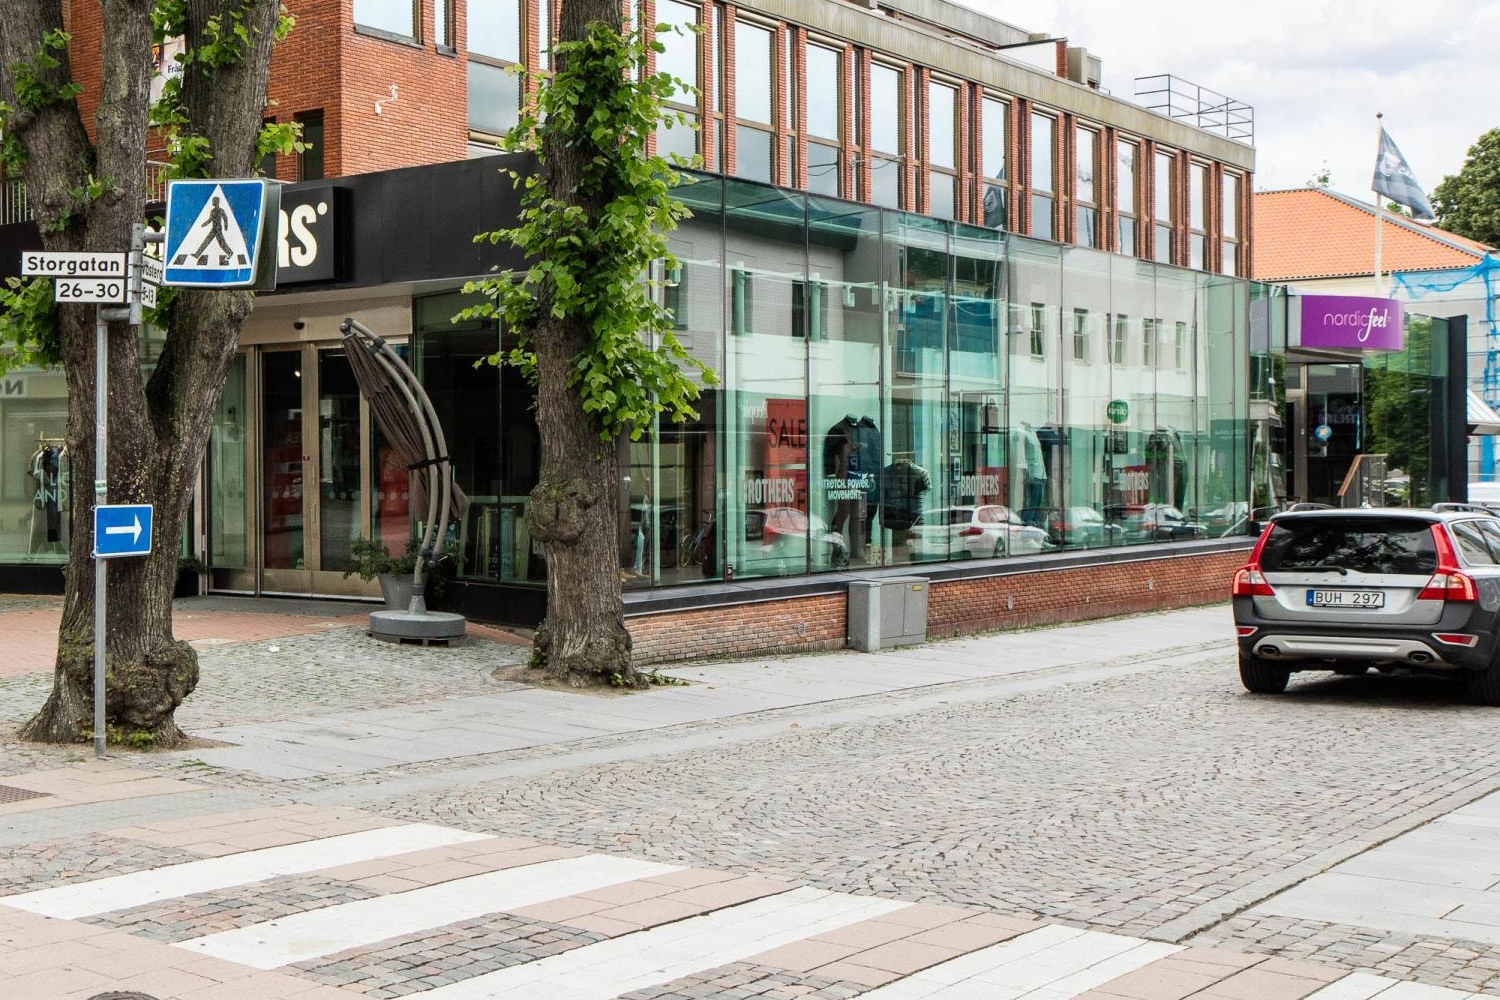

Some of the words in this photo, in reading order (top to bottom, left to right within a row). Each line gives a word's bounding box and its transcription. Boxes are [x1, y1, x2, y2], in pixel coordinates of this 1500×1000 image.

[27, 255, 120, 275] Storgatan
[59, 283, 120, 299] 26-30
[1323, 307, 1388, 342] nordicfeel
[769, 418, 806, 448] SALE
[961, 475, 1000, 497] BROTHERS
[1315, 592, 1343, 603] BUH
[1352, 593, 1381, 604] 297
